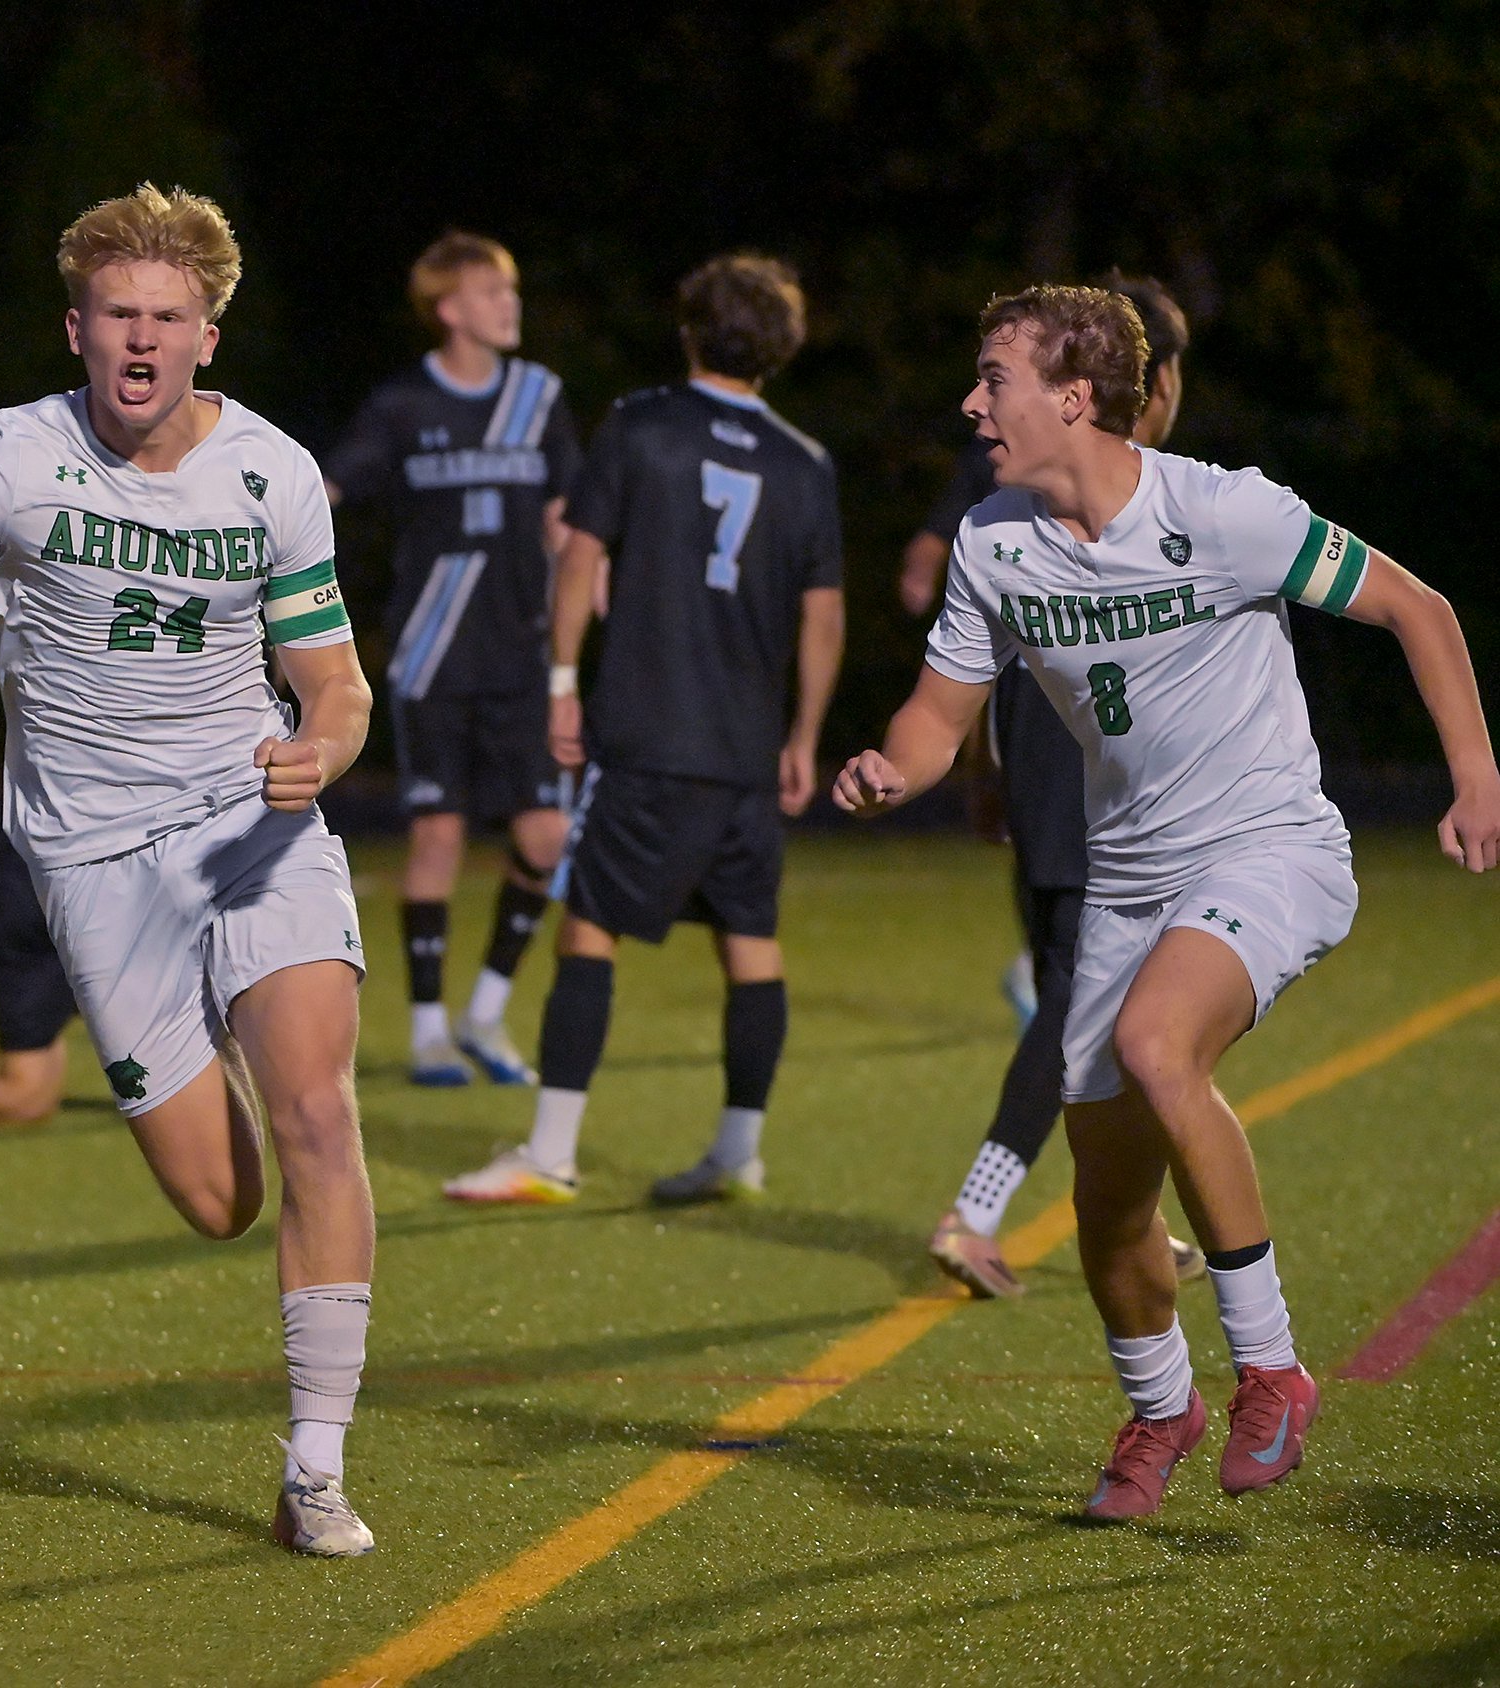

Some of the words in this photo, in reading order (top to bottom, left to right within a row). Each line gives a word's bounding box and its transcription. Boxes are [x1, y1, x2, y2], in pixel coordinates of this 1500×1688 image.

[41, 510, 273, 582] ARUNDEL
[701, 459, 762, 594] 7
[107, 587, 211, 653] 24
[313, 585, 339, 605] CAP
[1000, 583, 1216, 648] ARUNDEL
[1086, 661, 1133, 736] 8
